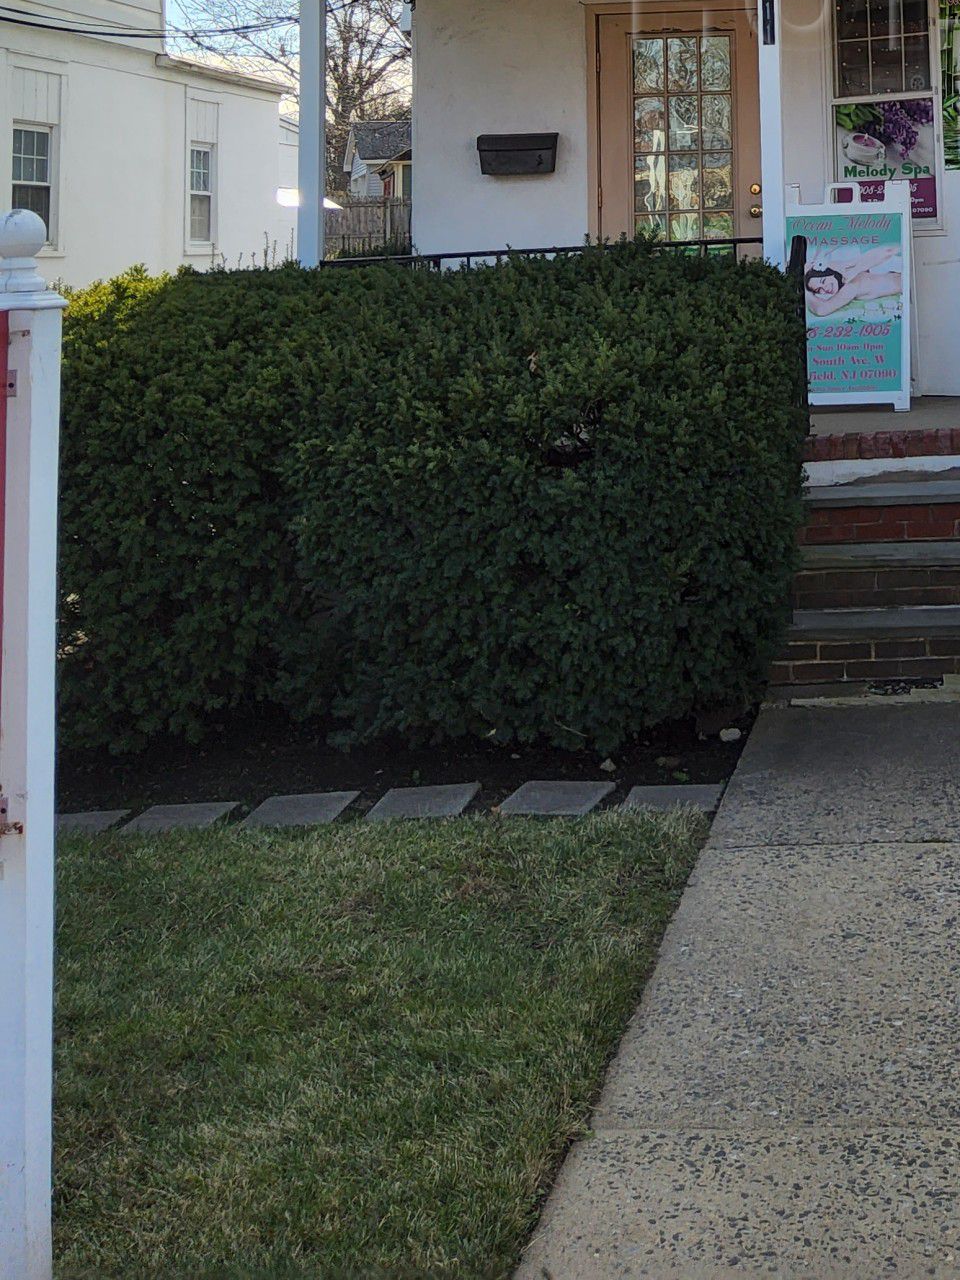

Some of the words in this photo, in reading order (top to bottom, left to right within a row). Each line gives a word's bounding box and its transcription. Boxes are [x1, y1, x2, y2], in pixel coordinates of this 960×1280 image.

[843, 164, 897, 181] Melody
[901, 163, 930, 178] Spa
[791, 219, 833, 230] Ocean
[839, 214, 891, 230] Melody
[806, 236, 880, 245] MASSAGE
[813, 357, 845, 366] South
